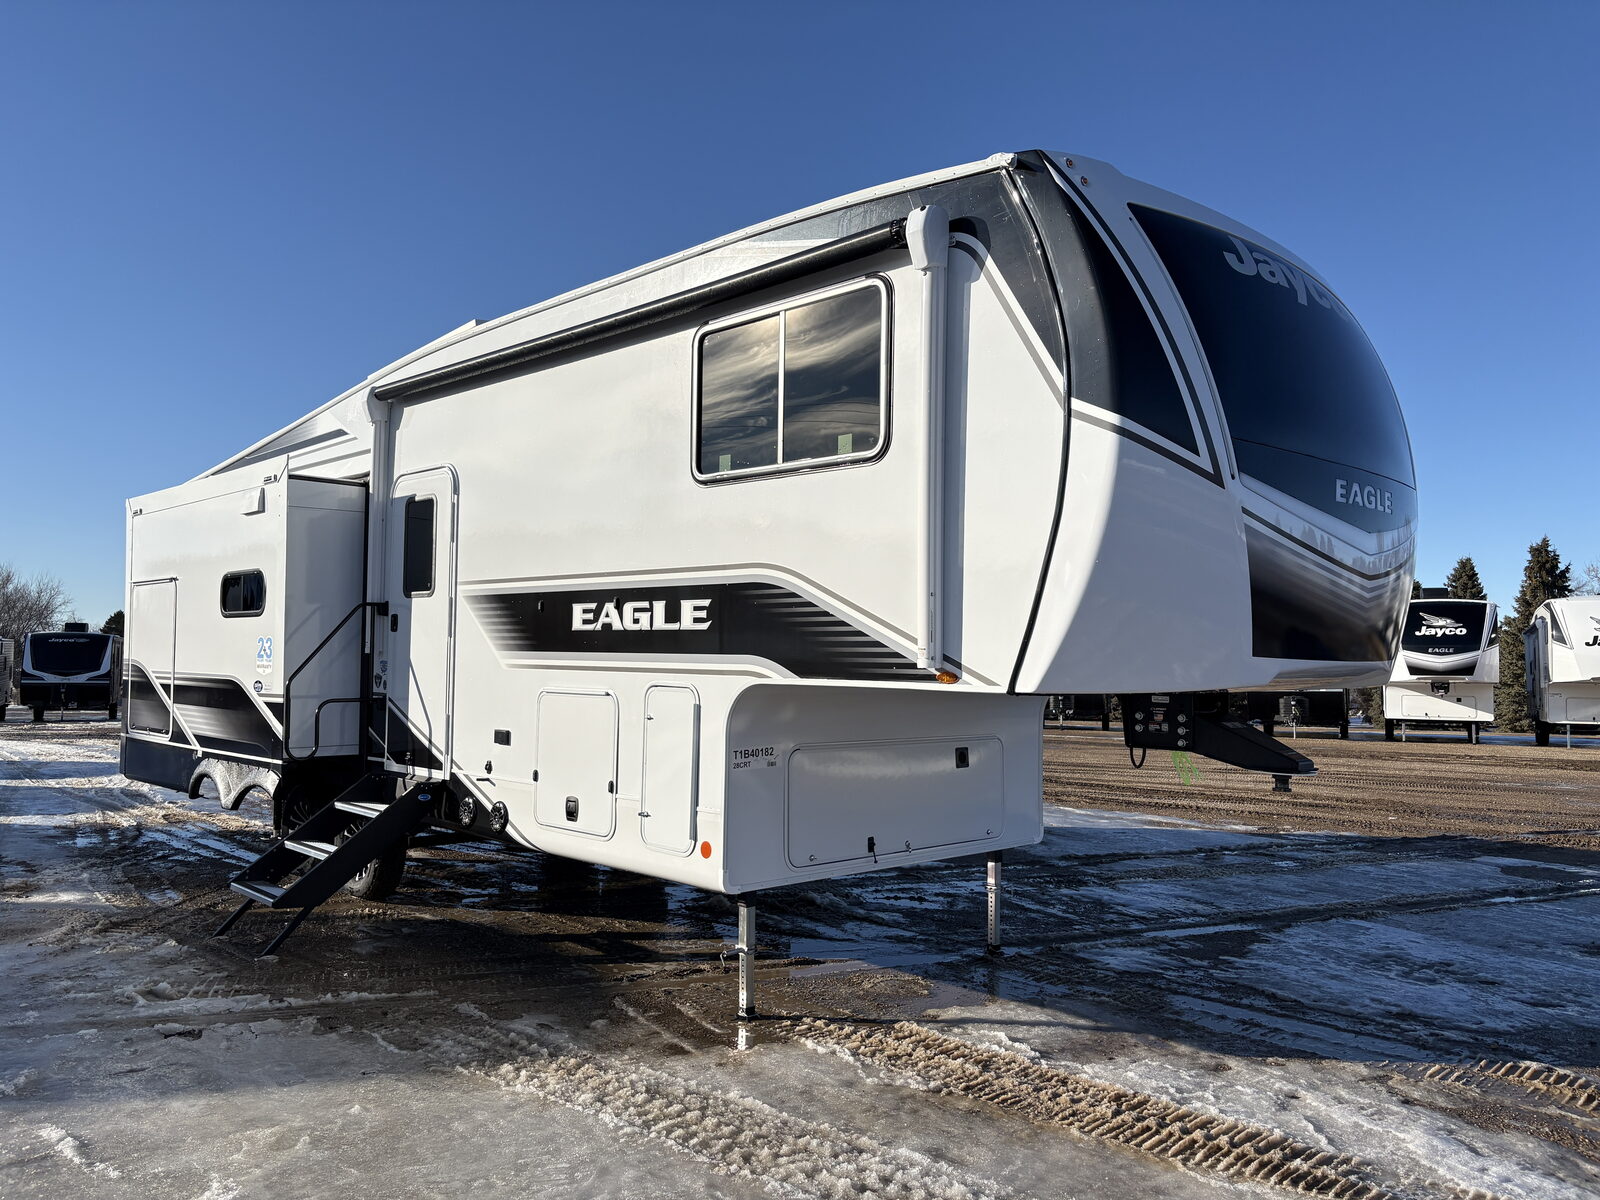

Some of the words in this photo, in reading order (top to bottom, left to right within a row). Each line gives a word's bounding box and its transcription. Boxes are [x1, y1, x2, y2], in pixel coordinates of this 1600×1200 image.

[1335, 479, 1393, 514] EAGLE
[571, 599, 712, 631] EAGLE
[1415, 625, 1467, 637] Jayco
[733, 747, 774, 760] T1B40182
